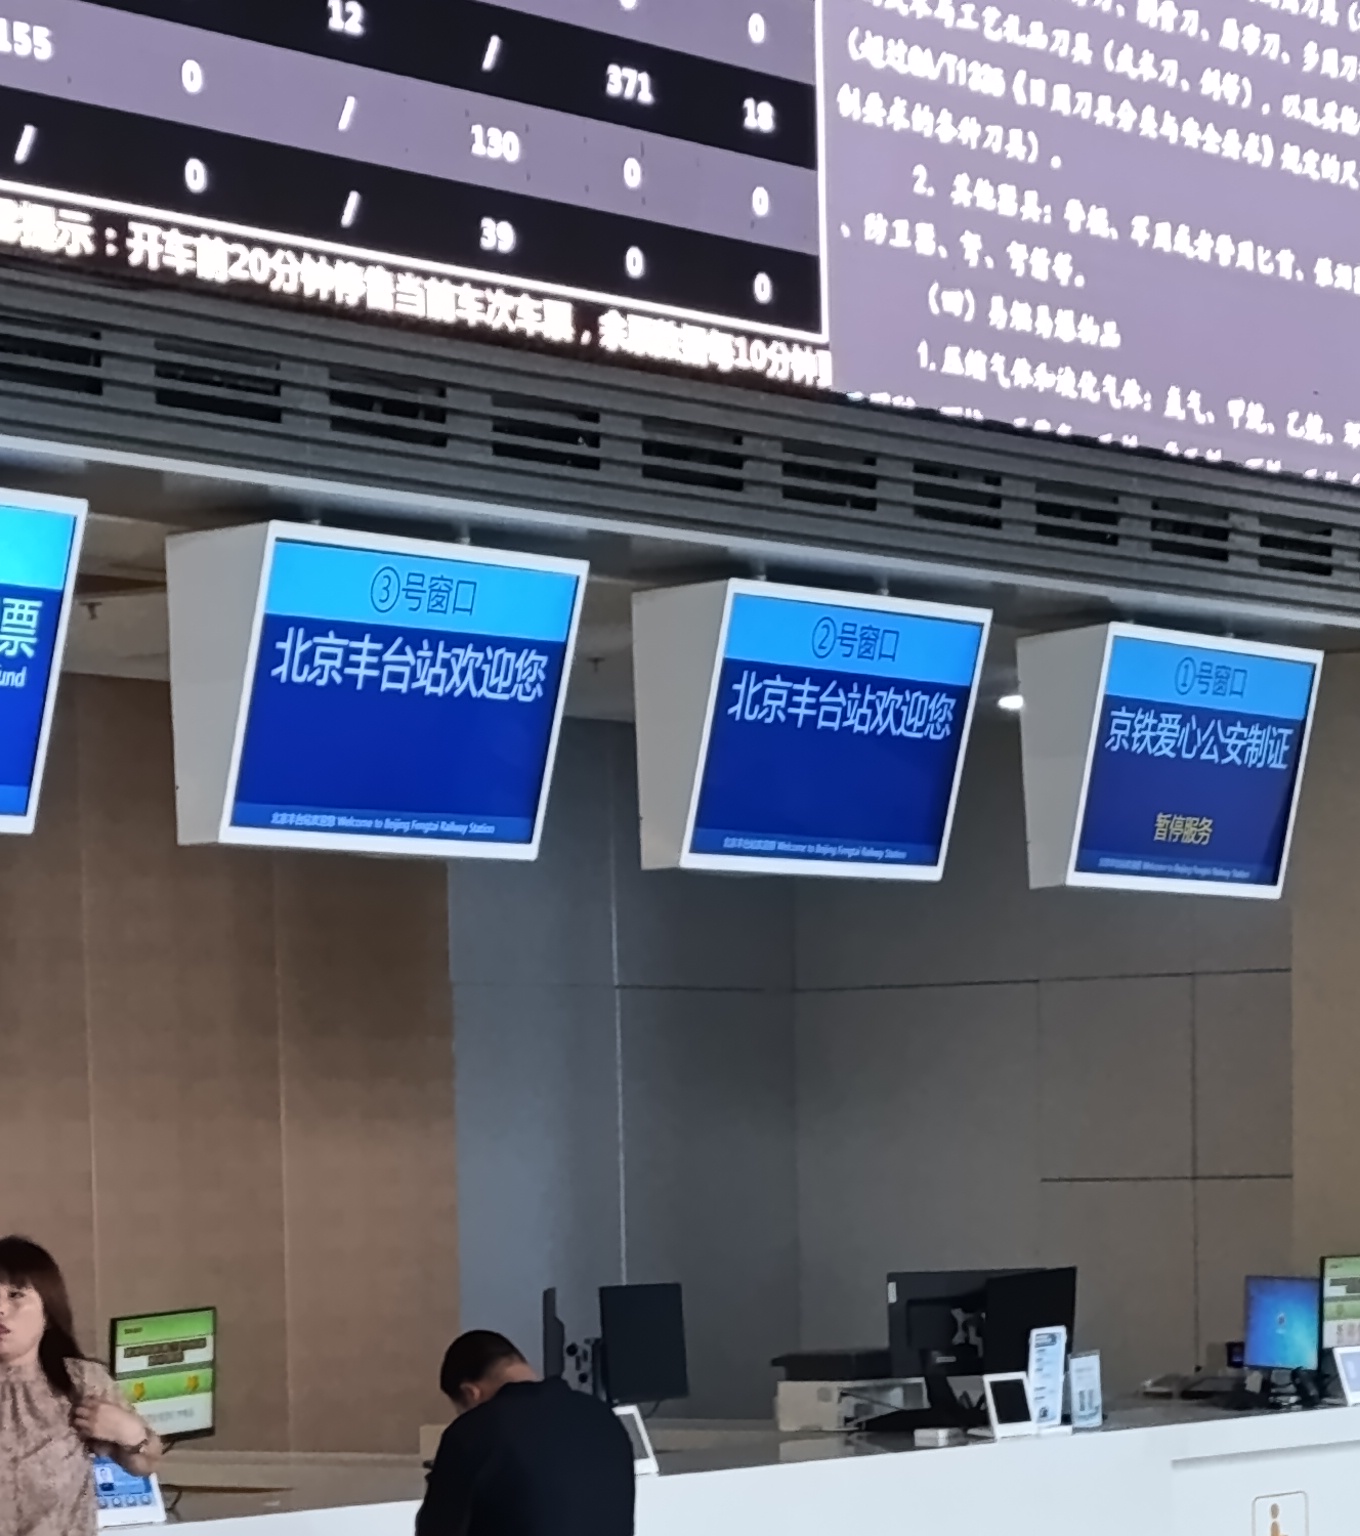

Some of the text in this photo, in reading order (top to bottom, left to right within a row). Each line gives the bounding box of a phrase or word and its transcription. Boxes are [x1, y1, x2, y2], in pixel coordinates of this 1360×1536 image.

[606, 65, 653, 103] 371
[743, 99, 774, 131] 18
[180, 59, 203, 93] 0
[470, 124, 520, 162] 130
[623, 157, 641, 188] 0
[751, 186, 769, 216] 0
[184, 158, 206, 191] 0
[480, 218, 515, 251] 39
[626, 247, 643, 277] 0
[753, 273, 771, 302] 0
[271, 626, 548, 702] 北京丰台站欢迎您
[727, 670, 956, 740] 北京丰台站欢迎您
[1105, 706, 1293, 770] 京铁爱心公安制证
[1154, 812, 1213, 845] 暂停服务
